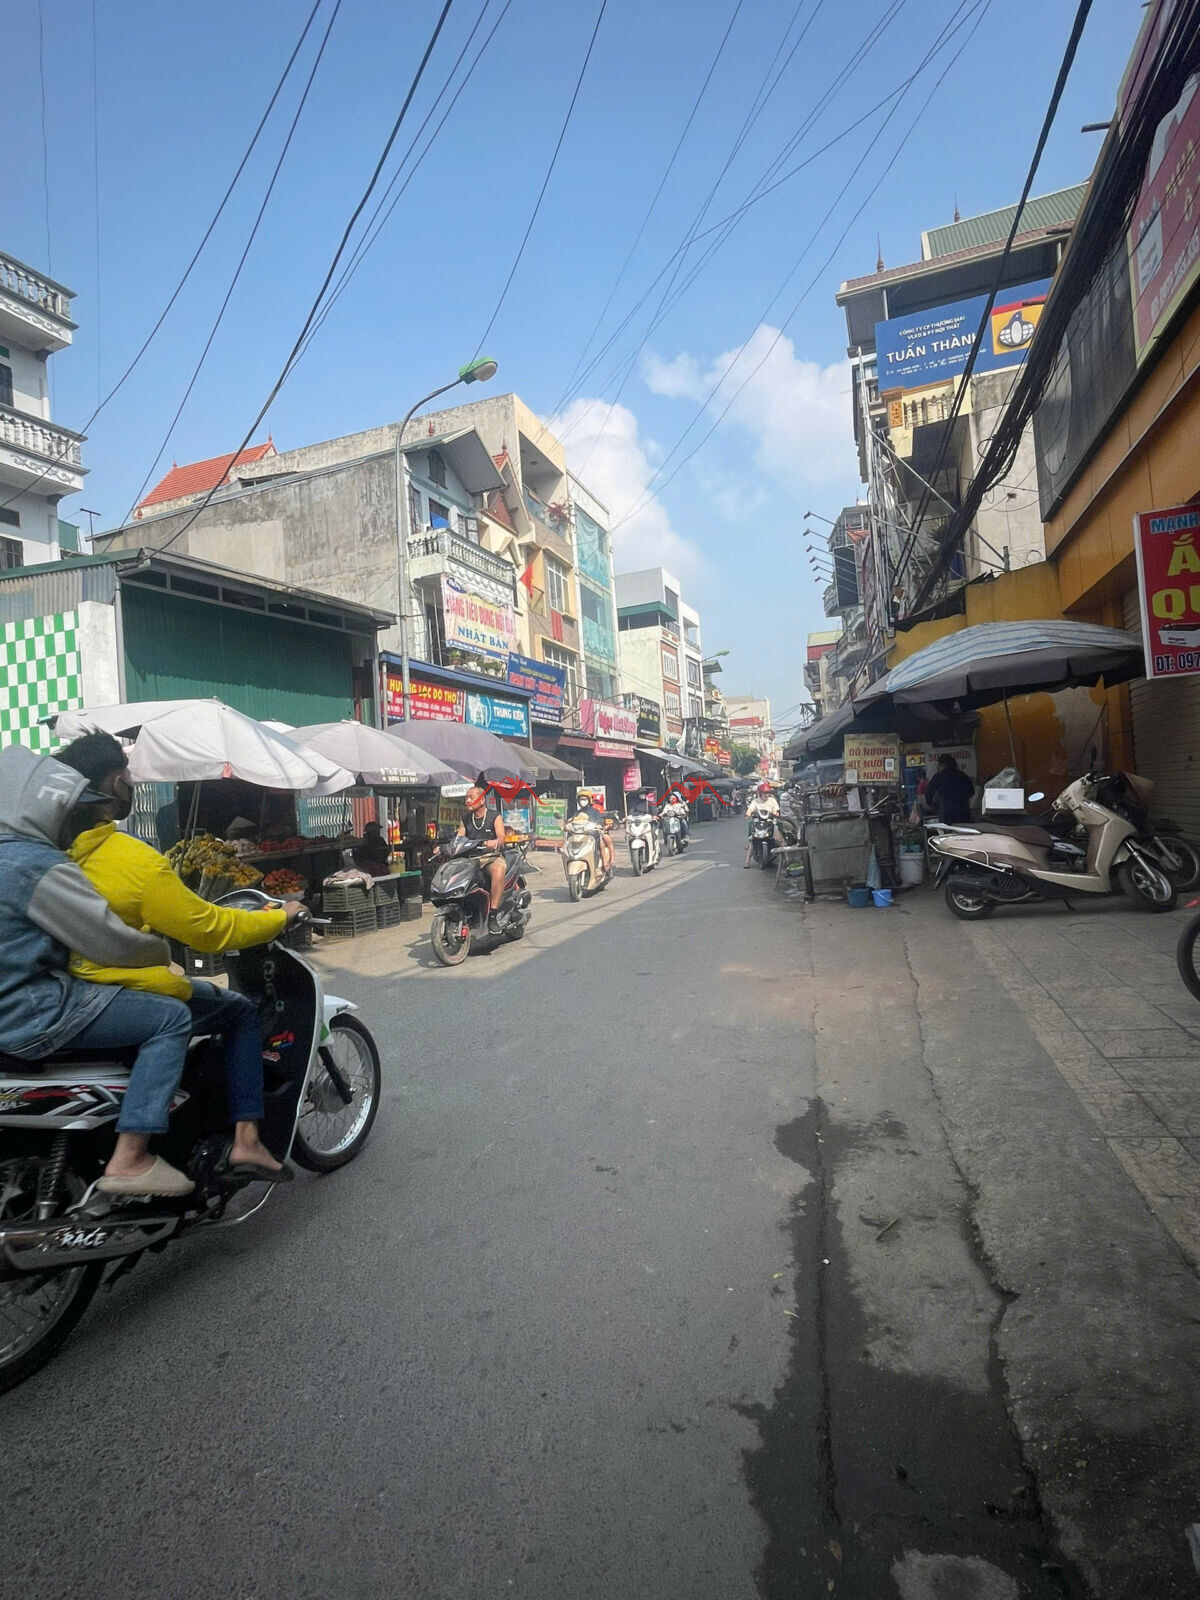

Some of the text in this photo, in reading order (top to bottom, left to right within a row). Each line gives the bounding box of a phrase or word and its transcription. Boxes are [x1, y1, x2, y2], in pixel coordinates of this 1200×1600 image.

[886, 342, 926, 364] TUẤN
[1150, 512, 1199, 535] MẠNH
[458, 625, 487, 644] NHẬT
[493, 706, 512, 719] TRUNG
[60, 1226, 107, 1247] RACE
